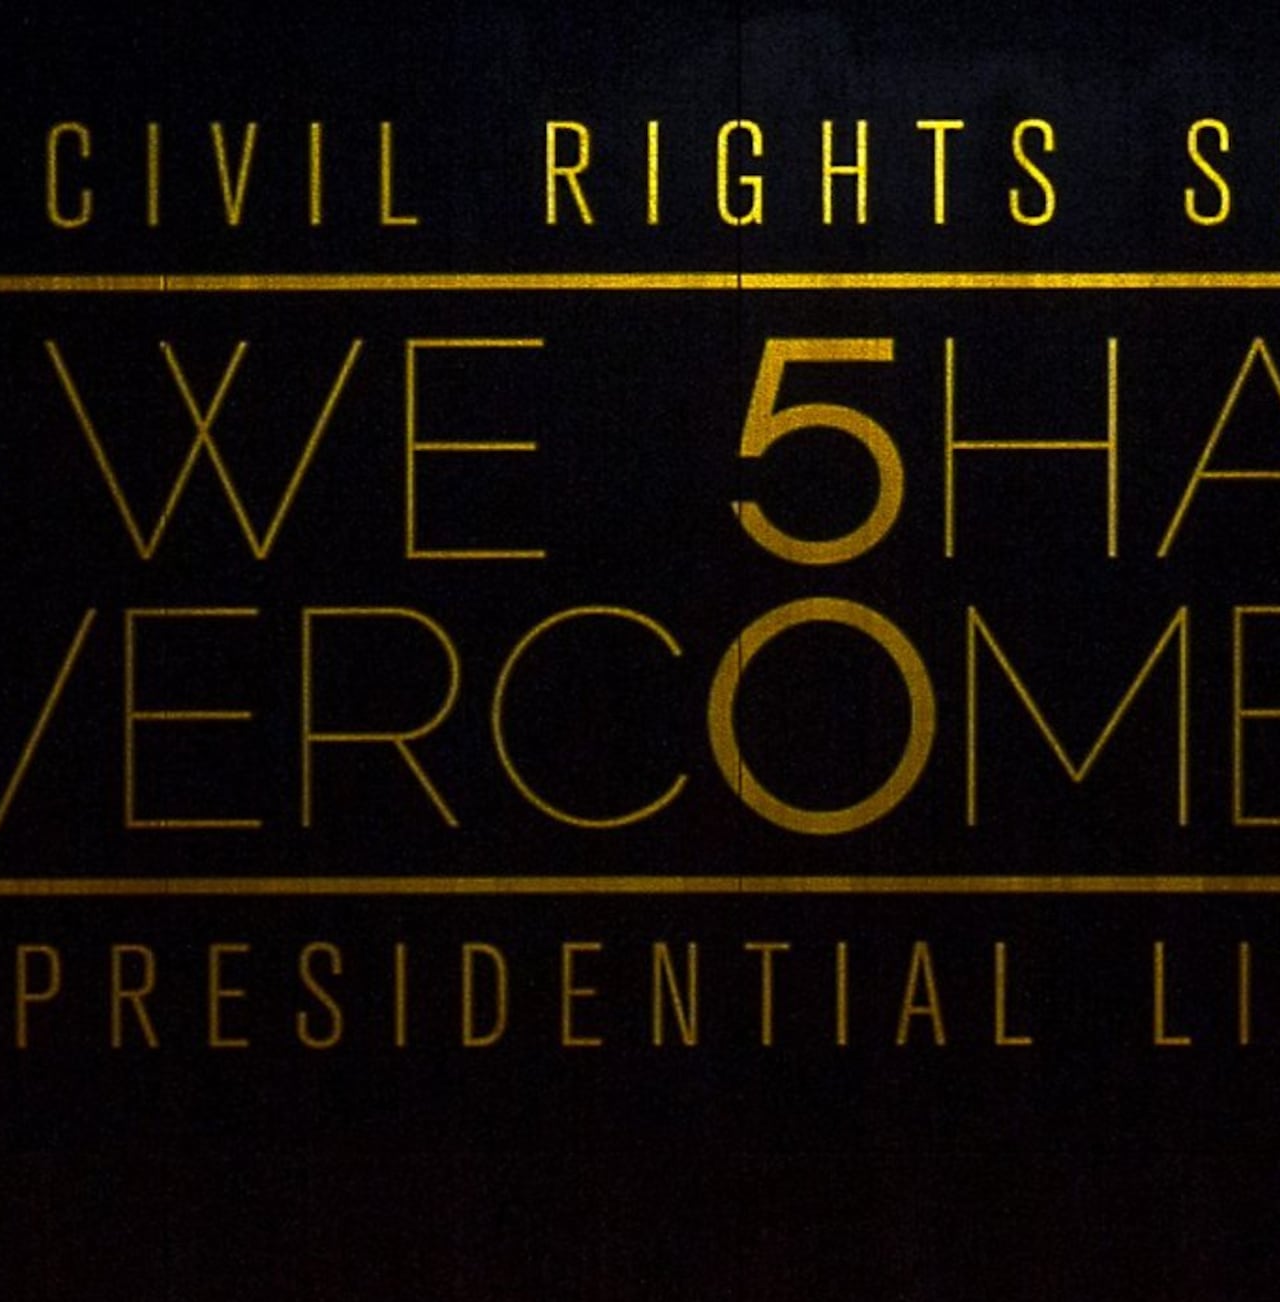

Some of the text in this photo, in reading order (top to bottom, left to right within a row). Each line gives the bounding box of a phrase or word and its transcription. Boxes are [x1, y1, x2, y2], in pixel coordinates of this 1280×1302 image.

[47, 121, 419, 229] CIVIL
[545, 117, 1056, 227] RIGHTS
[46, 337, 546, 560] WE
[18, 941, 1032, 1048] PRESIDENTIAL
